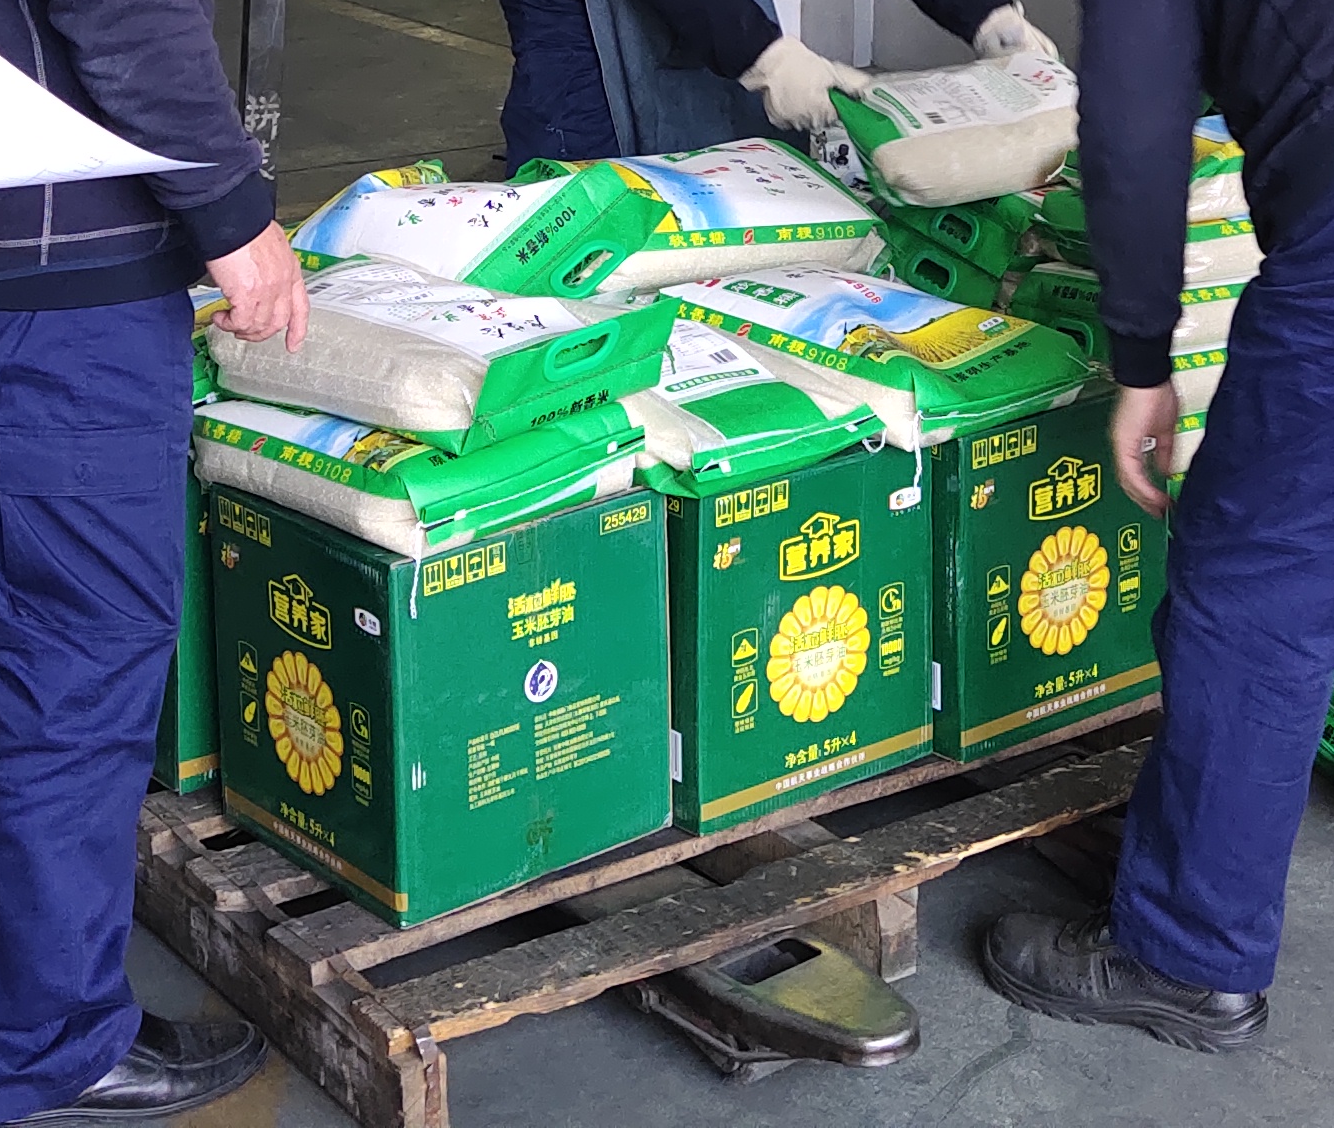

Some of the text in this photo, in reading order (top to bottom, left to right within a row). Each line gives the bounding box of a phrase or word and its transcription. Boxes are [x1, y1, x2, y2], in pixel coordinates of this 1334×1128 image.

[669, 231, 726, 247] 软香糯
[776, 225, 856, 241] 南粳9108
[1179, 286, 1231, 304] 软香糯
[768, 333, 848, 371] 南粳9108
[1173, 350, 1225, 370] 软香糯
[279, 445, 352, 484] 南粳9108
[1035, 474, 1096, 515] 营养家
[603, 505, 648, 532] 255429
[786, 530, 855, 575] 营养家
[273, 590, 327, 643] 营养家
[511, 605, 575, 640] 玉米胚芽油
